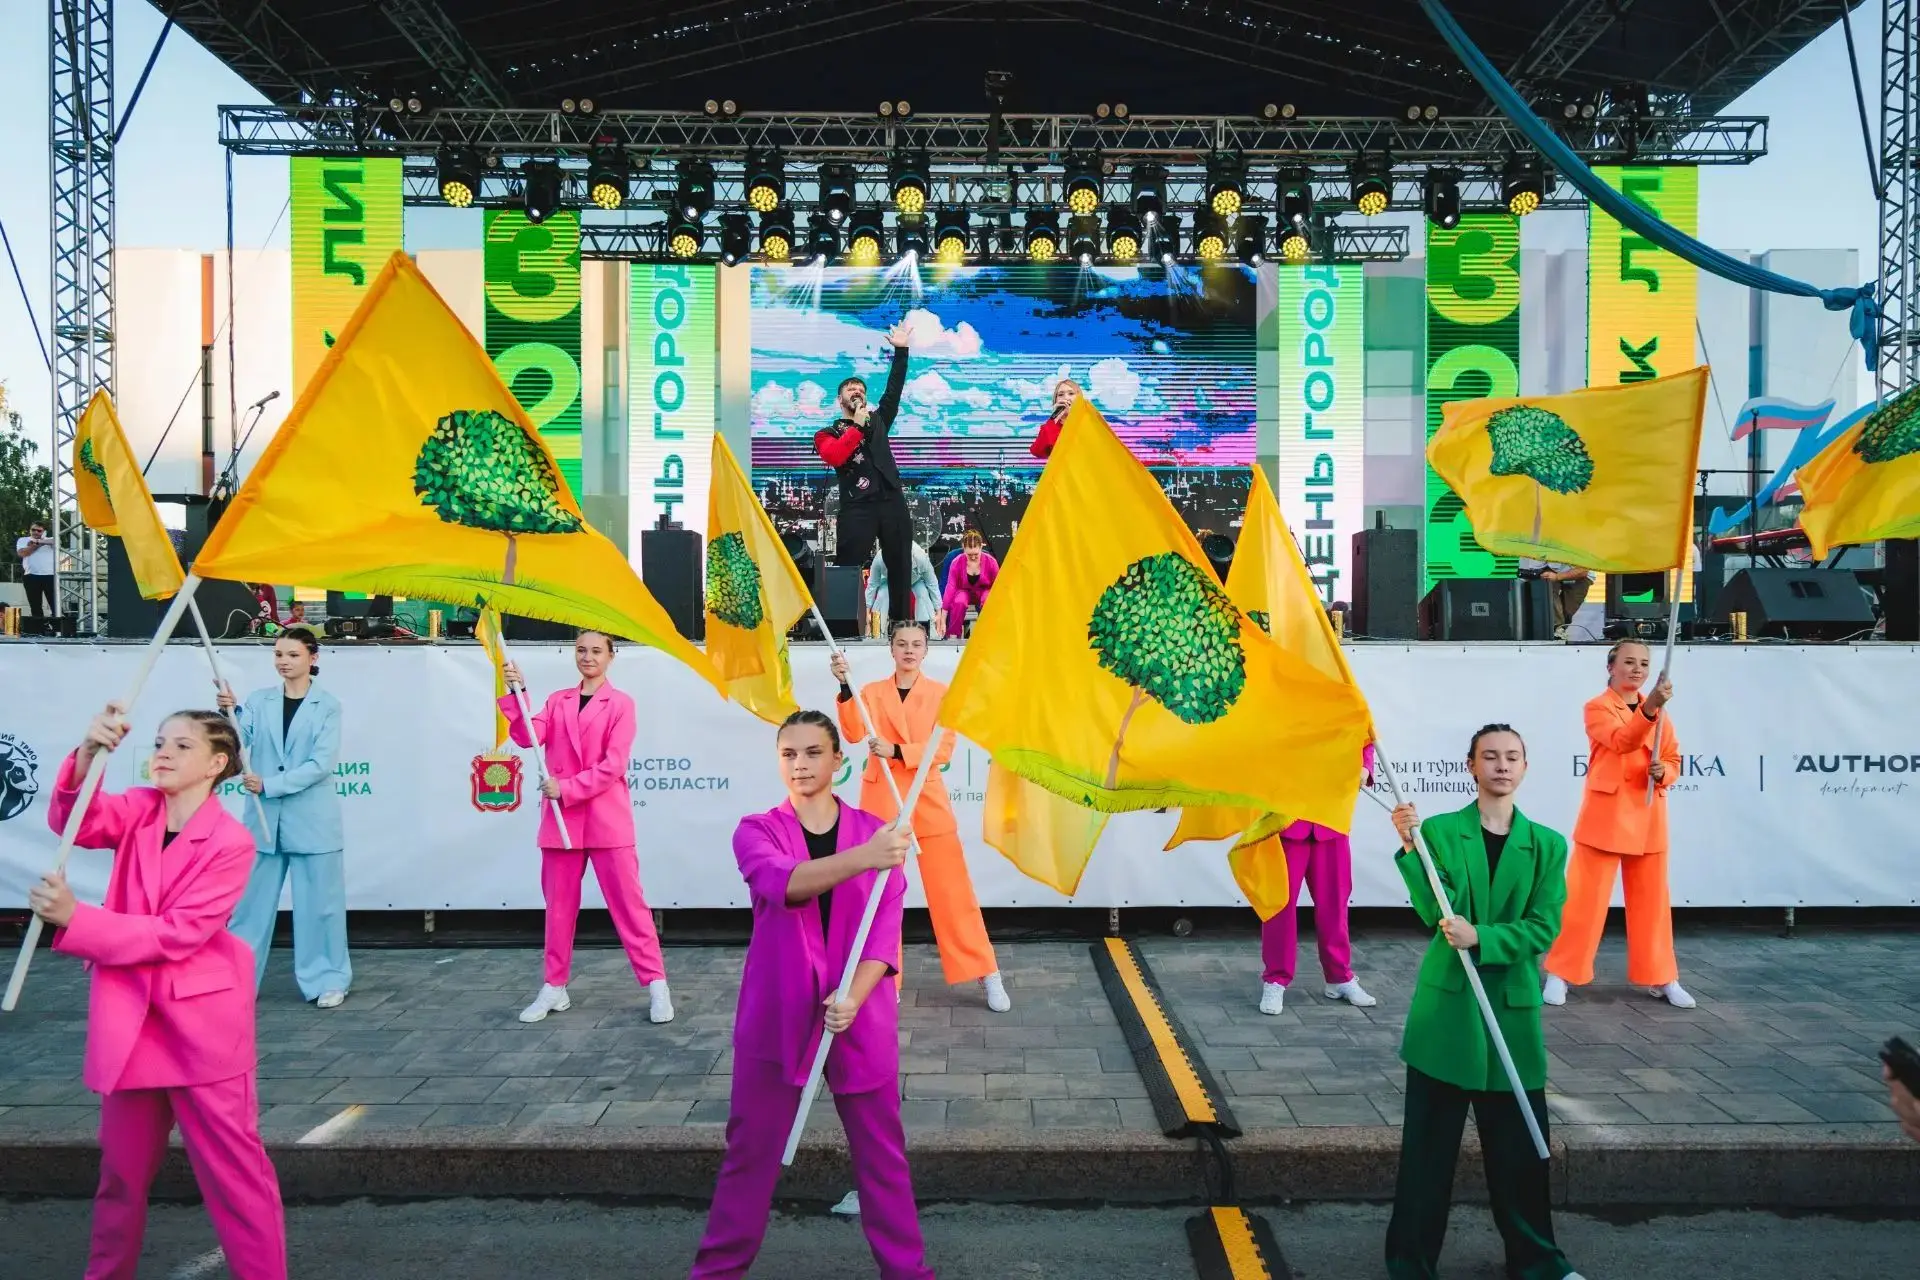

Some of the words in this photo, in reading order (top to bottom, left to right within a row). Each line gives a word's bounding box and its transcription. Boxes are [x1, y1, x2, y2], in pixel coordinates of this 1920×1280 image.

[323, 156, 366, 286] ЛИ
[1621, 165, 1663, 293] ЛИ
[654, 264, 691, 440] ГОРОД
[1304, 265, 1340, 441] ГОРОД
[654, 454, 684, 530] НЬ
[0, 732, 15, 743] ИЙ
[20, 740, 38, 761] ТРИО
[332, 762, 370, 777] ЦИЯ
[627, 758, 692, 772] ЬСТВО
[1413, 761, 1422, 773] и
[335, 782, 371, 797] ЦКА
[627, 774, 639, 790] Й
[644, 777, 729, 790] ОБЛАСТИ
[1413, 778, 1479, 796] Липецка
[1669, 784, 1699, 792] РТАЛ
[633, 800, 647, 808] РФ
